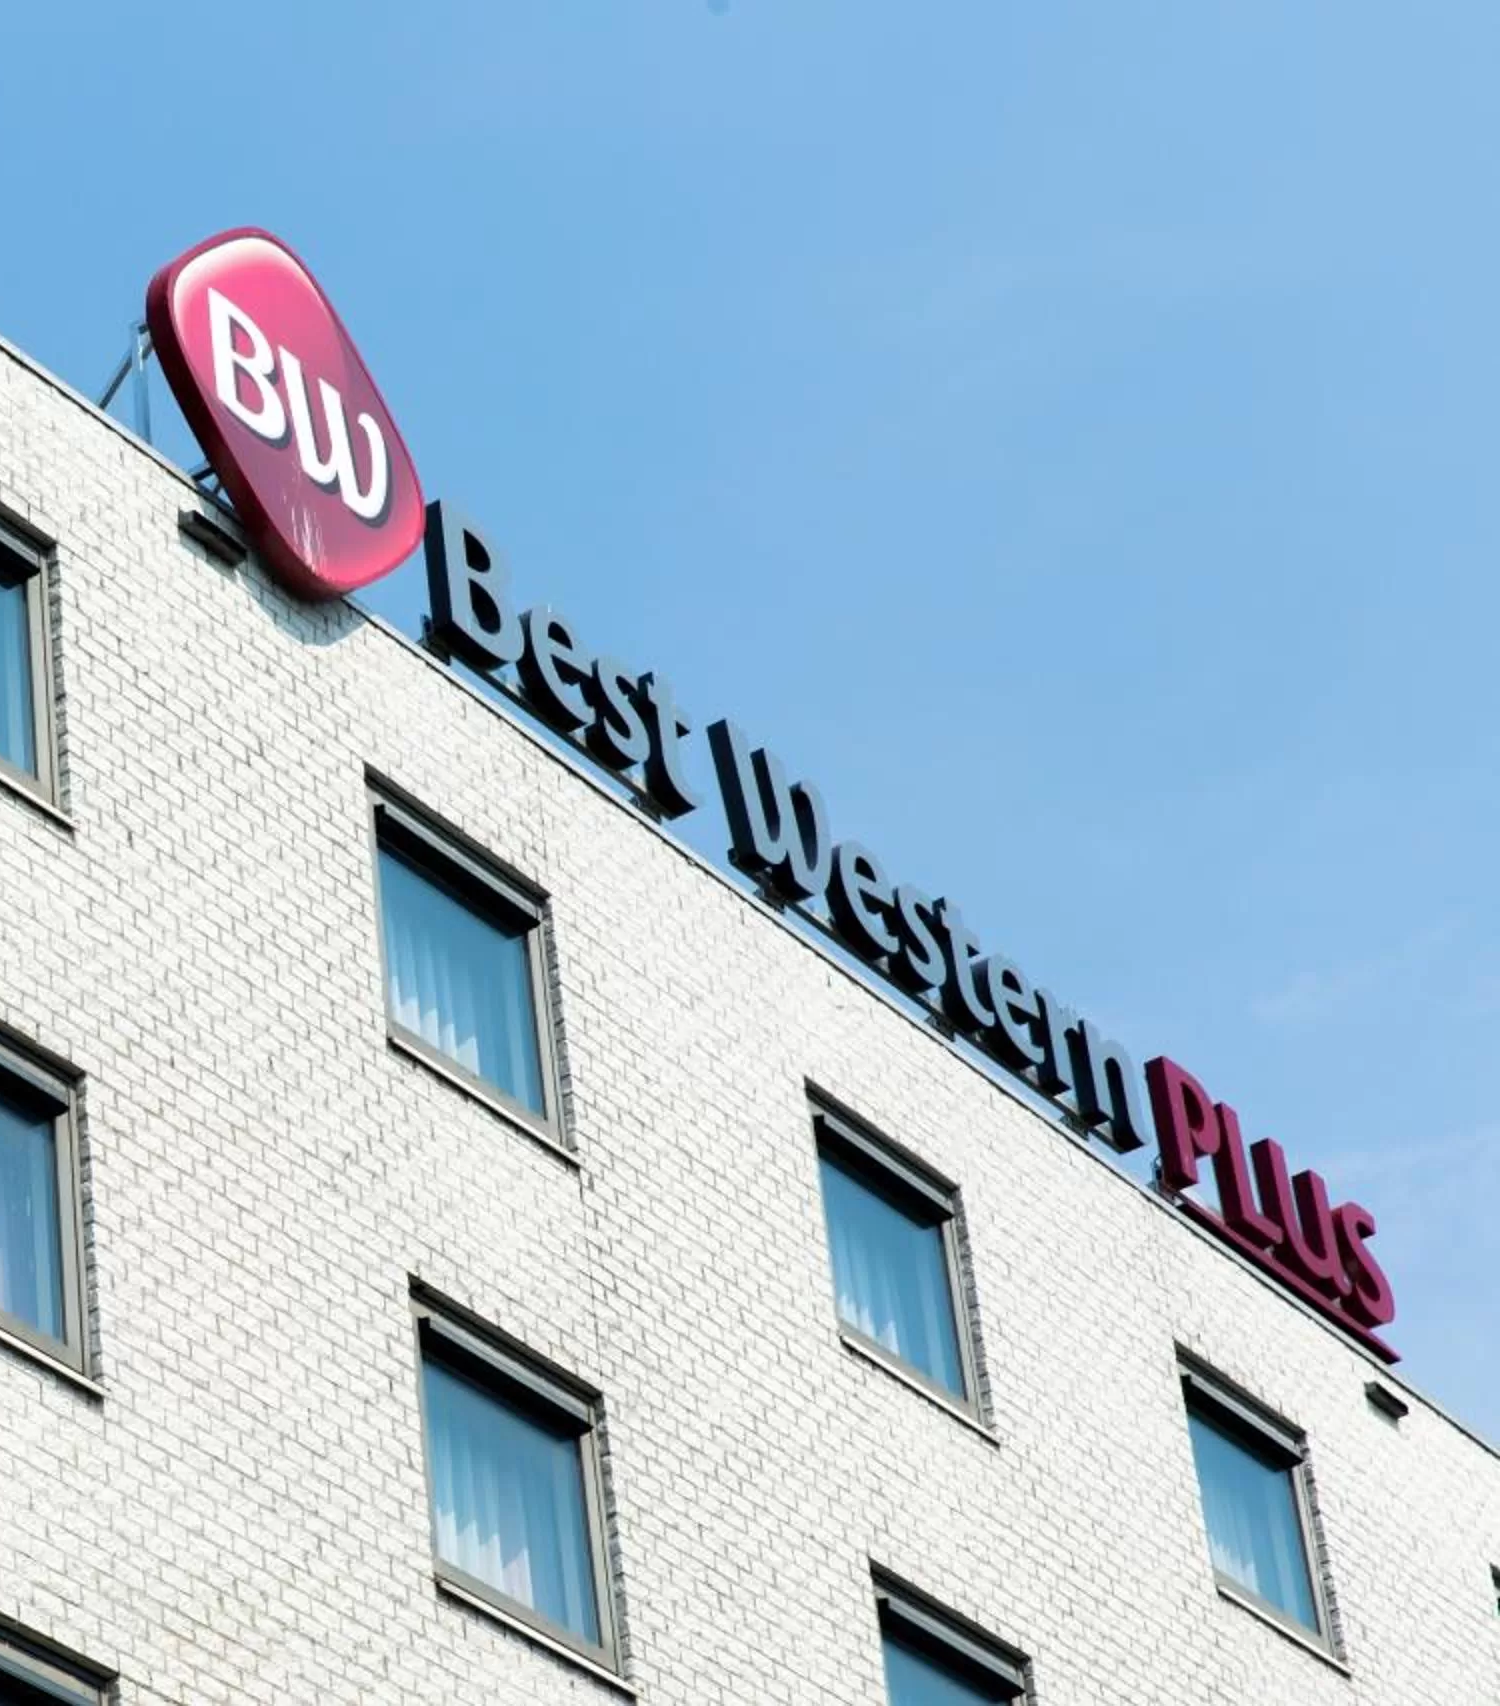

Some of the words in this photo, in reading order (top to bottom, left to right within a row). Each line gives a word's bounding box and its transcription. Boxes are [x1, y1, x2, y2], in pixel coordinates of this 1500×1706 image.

[207, 287, 389, 520] BW
[425, 499, 699, 820] Best
[707, 719, 1151, 1153] Western
[1145, 1056, 1396, 1328] PLUS
